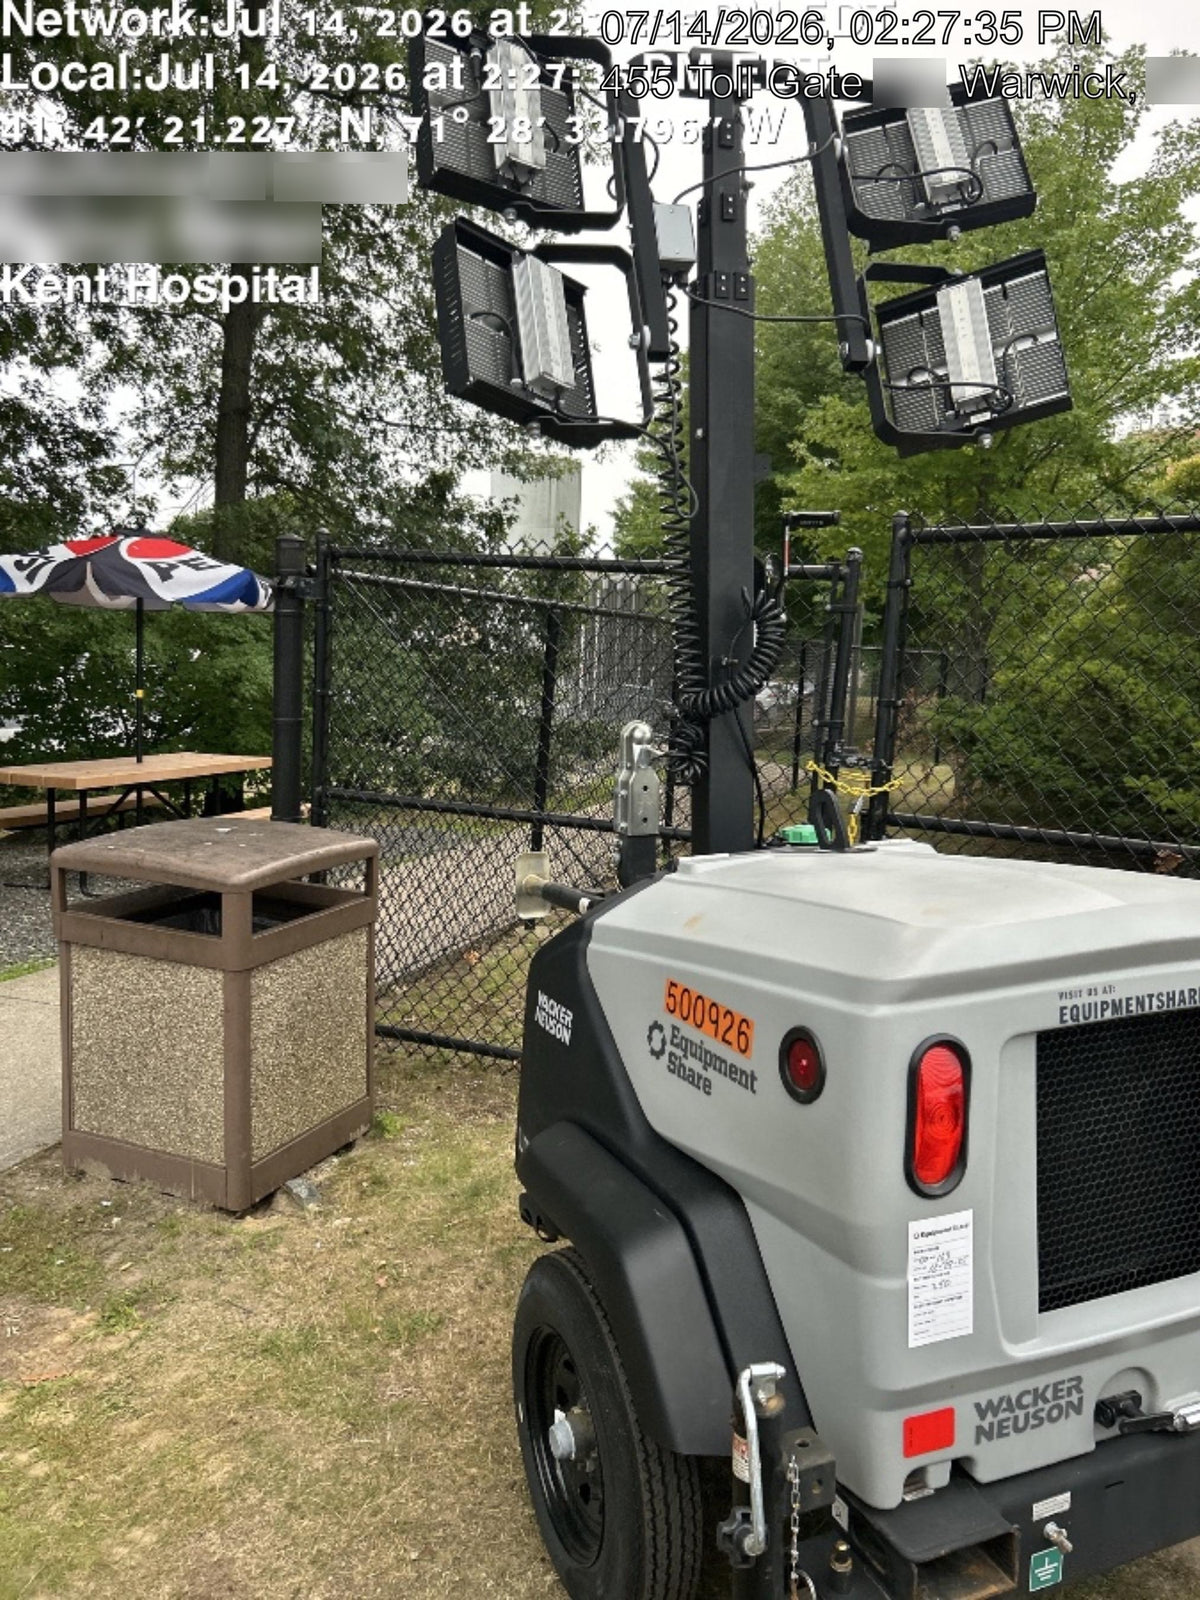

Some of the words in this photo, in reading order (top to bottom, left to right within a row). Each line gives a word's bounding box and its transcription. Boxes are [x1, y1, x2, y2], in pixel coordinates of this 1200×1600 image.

[534, 1005, 572, 1047] NEUSON
[538, 989, 574, 1029] WACKER
[666, 980, 751, 1055] 500926
[1059, 986, 1200, 1025] EQUIPMENTSHAR
[666, 1051, 713, 1097] Share
[669, 1023, 759, 1096] Equipment
[974, 1375, 1084, 1421] WACKER
[974, 1395, 1084, 1446] NEUSON
